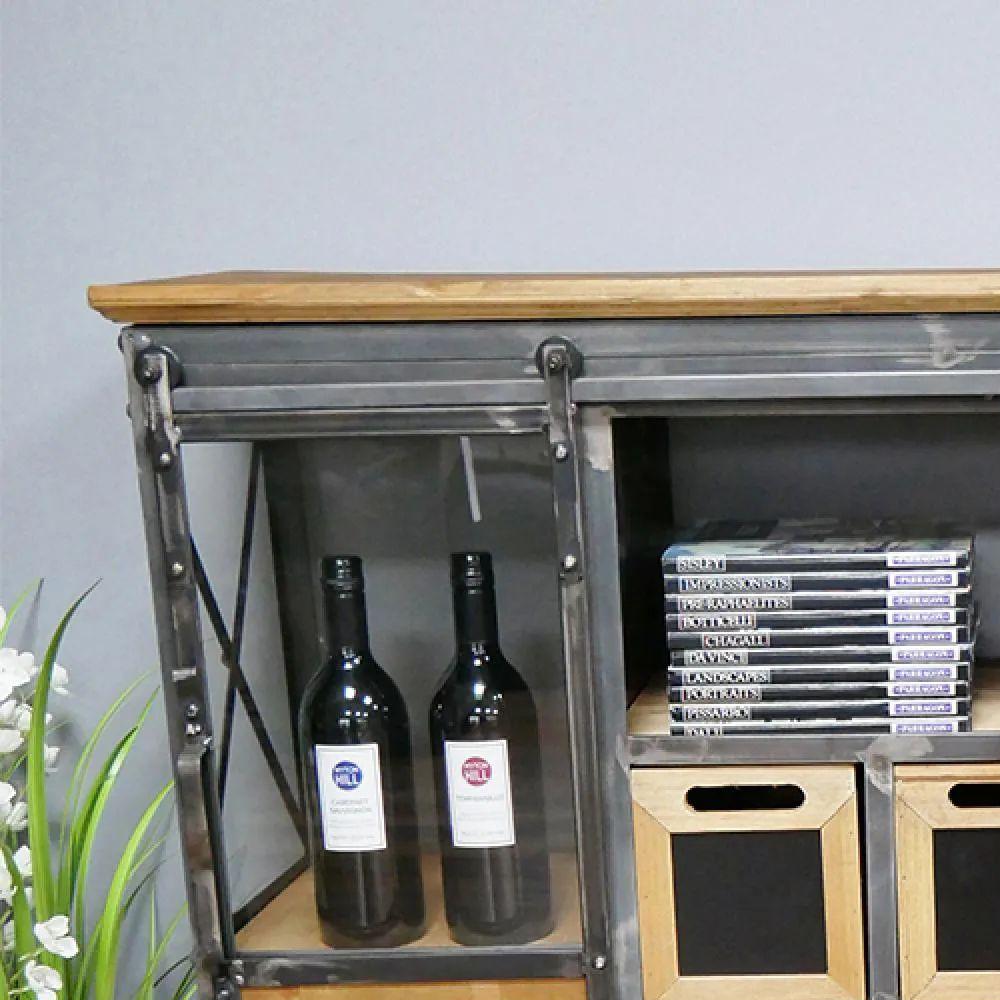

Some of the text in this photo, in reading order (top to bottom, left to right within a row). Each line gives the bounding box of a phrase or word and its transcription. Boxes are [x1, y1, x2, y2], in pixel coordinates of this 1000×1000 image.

[704, 635, 764, 647] CHAGALL
[686, 671, 767, 683] LANDSCAPES
[687, 688, 758, 700] PORTRAITS
